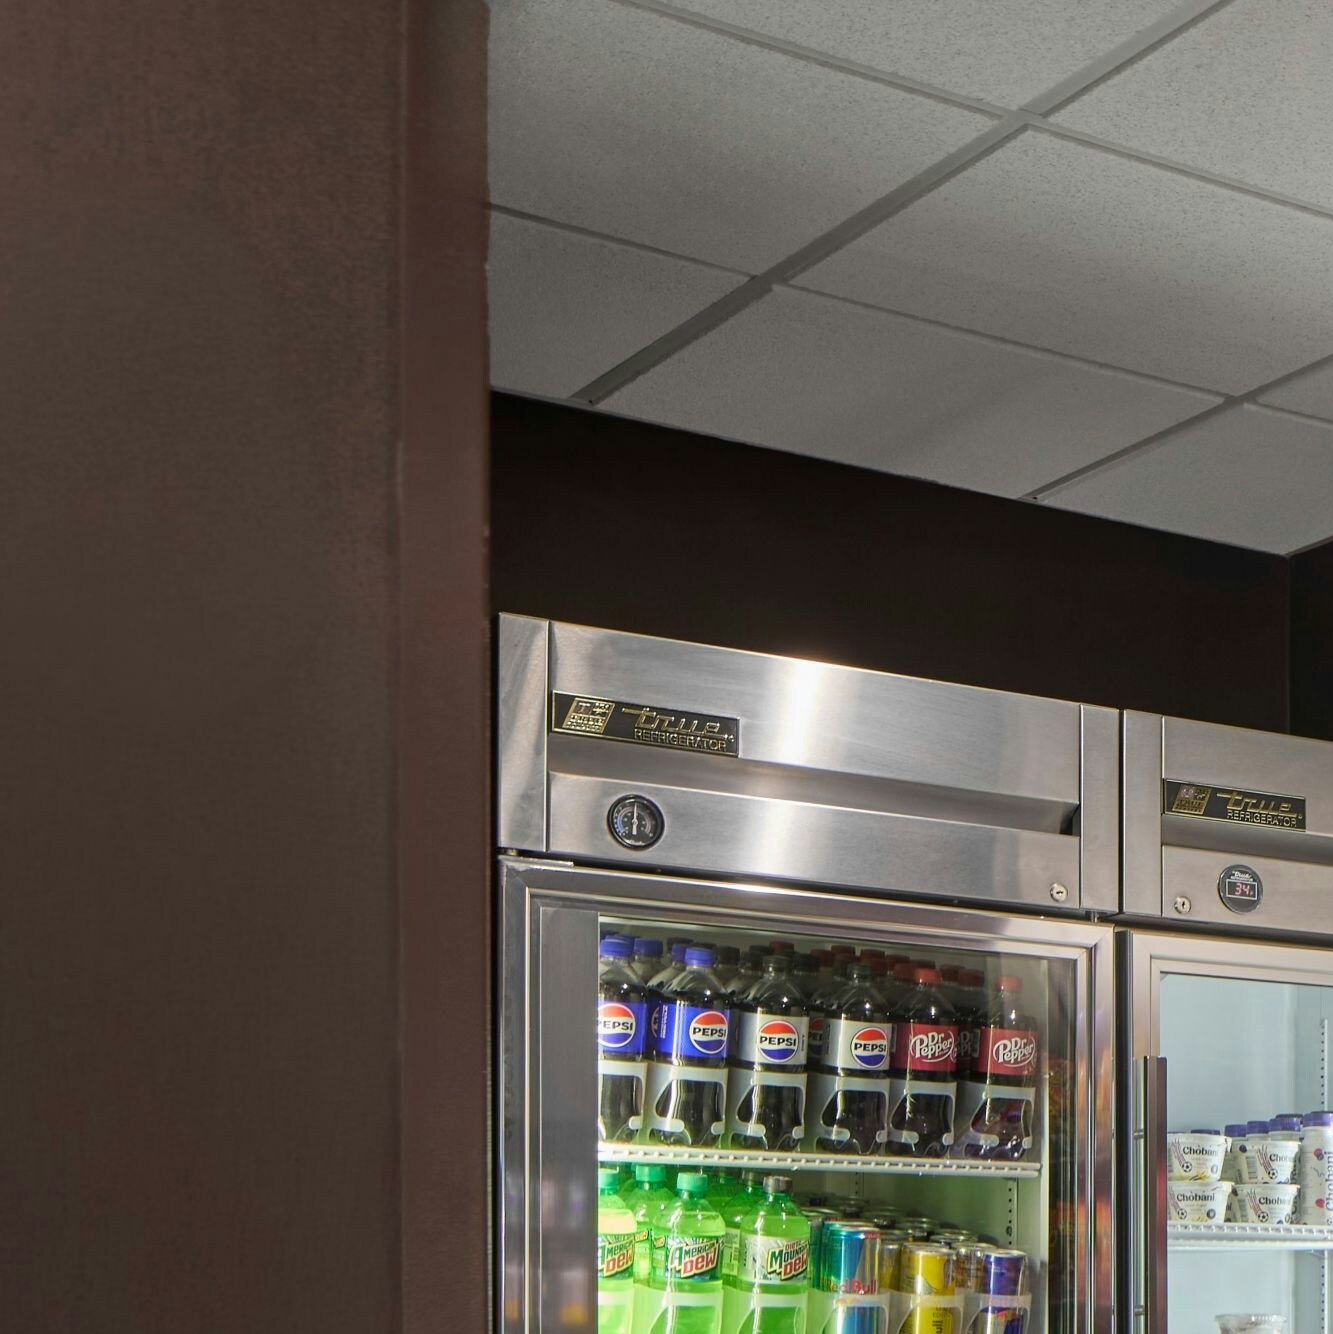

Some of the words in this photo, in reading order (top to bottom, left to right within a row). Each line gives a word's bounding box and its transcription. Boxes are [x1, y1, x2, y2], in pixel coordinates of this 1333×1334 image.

[634, 728, 727, 752] REFRIGERATOR
[1226, 809, 1297, 828] REFRIGERATOR
[692, 1027, 727, 1039] PEPSI
[928, 1032, 945, 1046] Dr
[759, 1036, 798, 1047] PEPSI
[853, 1042, 887, 1053] PEPSI
[913, 1034, 953, 1060] Pepper
[1011, 1037, 1028, 1051] Dr
[997, 1039, 1034, 1065] Pepper
[1176, 1190, 1216, 1203] Chobani
